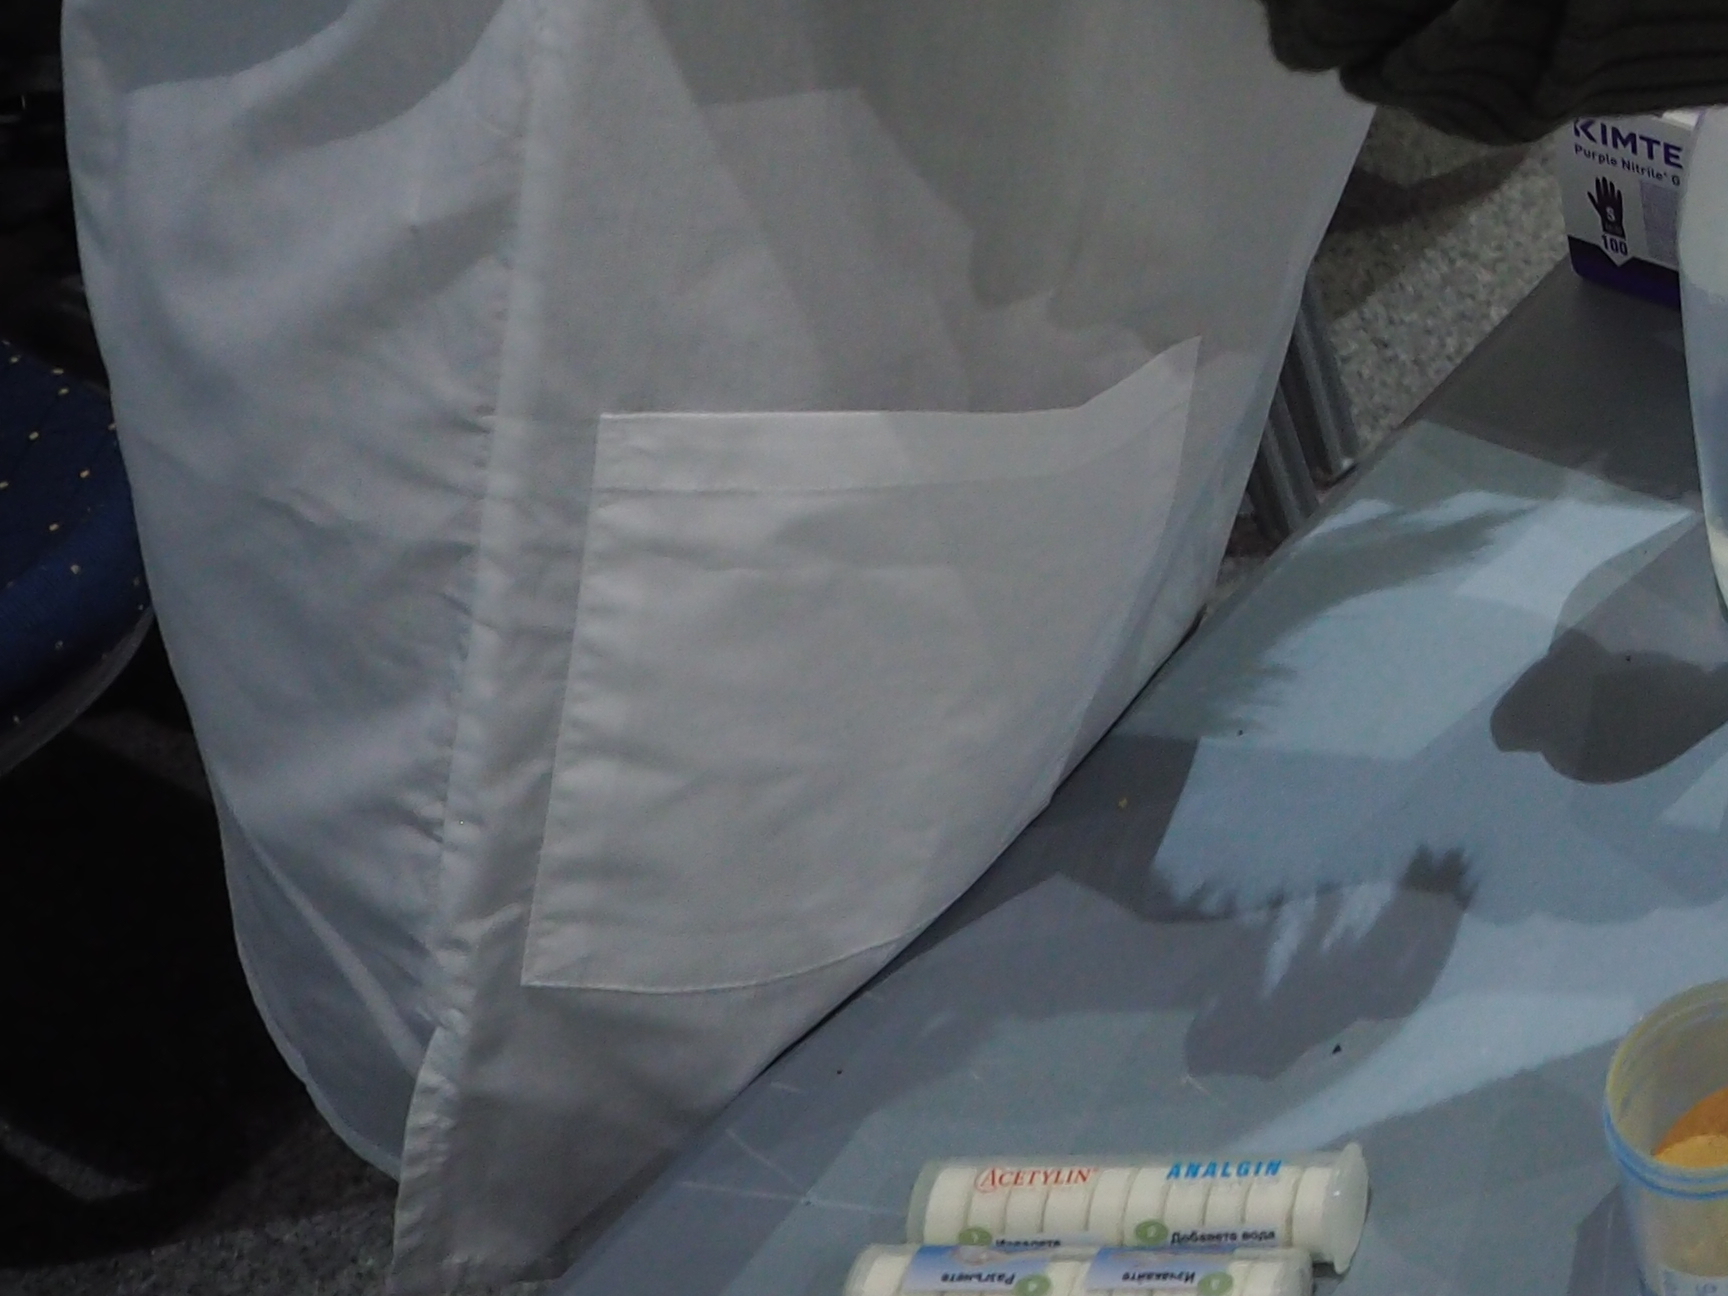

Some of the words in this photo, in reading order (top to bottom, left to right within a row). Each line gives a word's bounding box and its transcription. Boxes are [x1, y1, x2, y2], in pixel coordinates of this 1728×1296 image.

[1573, 119, 1684, 170] KIMTE
[1574, 143, 1618, 167] Purple
[1621, 158, 1668, 181] Nitrile
[1601, 233, 1628, 257] 100
[974, 1165, 1092, 1194] ACETYLIN
[1166, 1159, 1284, 1181] ANALGIN
[1171, 1229, 1238, 1247] Добавете
[1242, 1228, 1276, 1244] вода
[1120, 1270, 1198, 1285] Изчакайте
